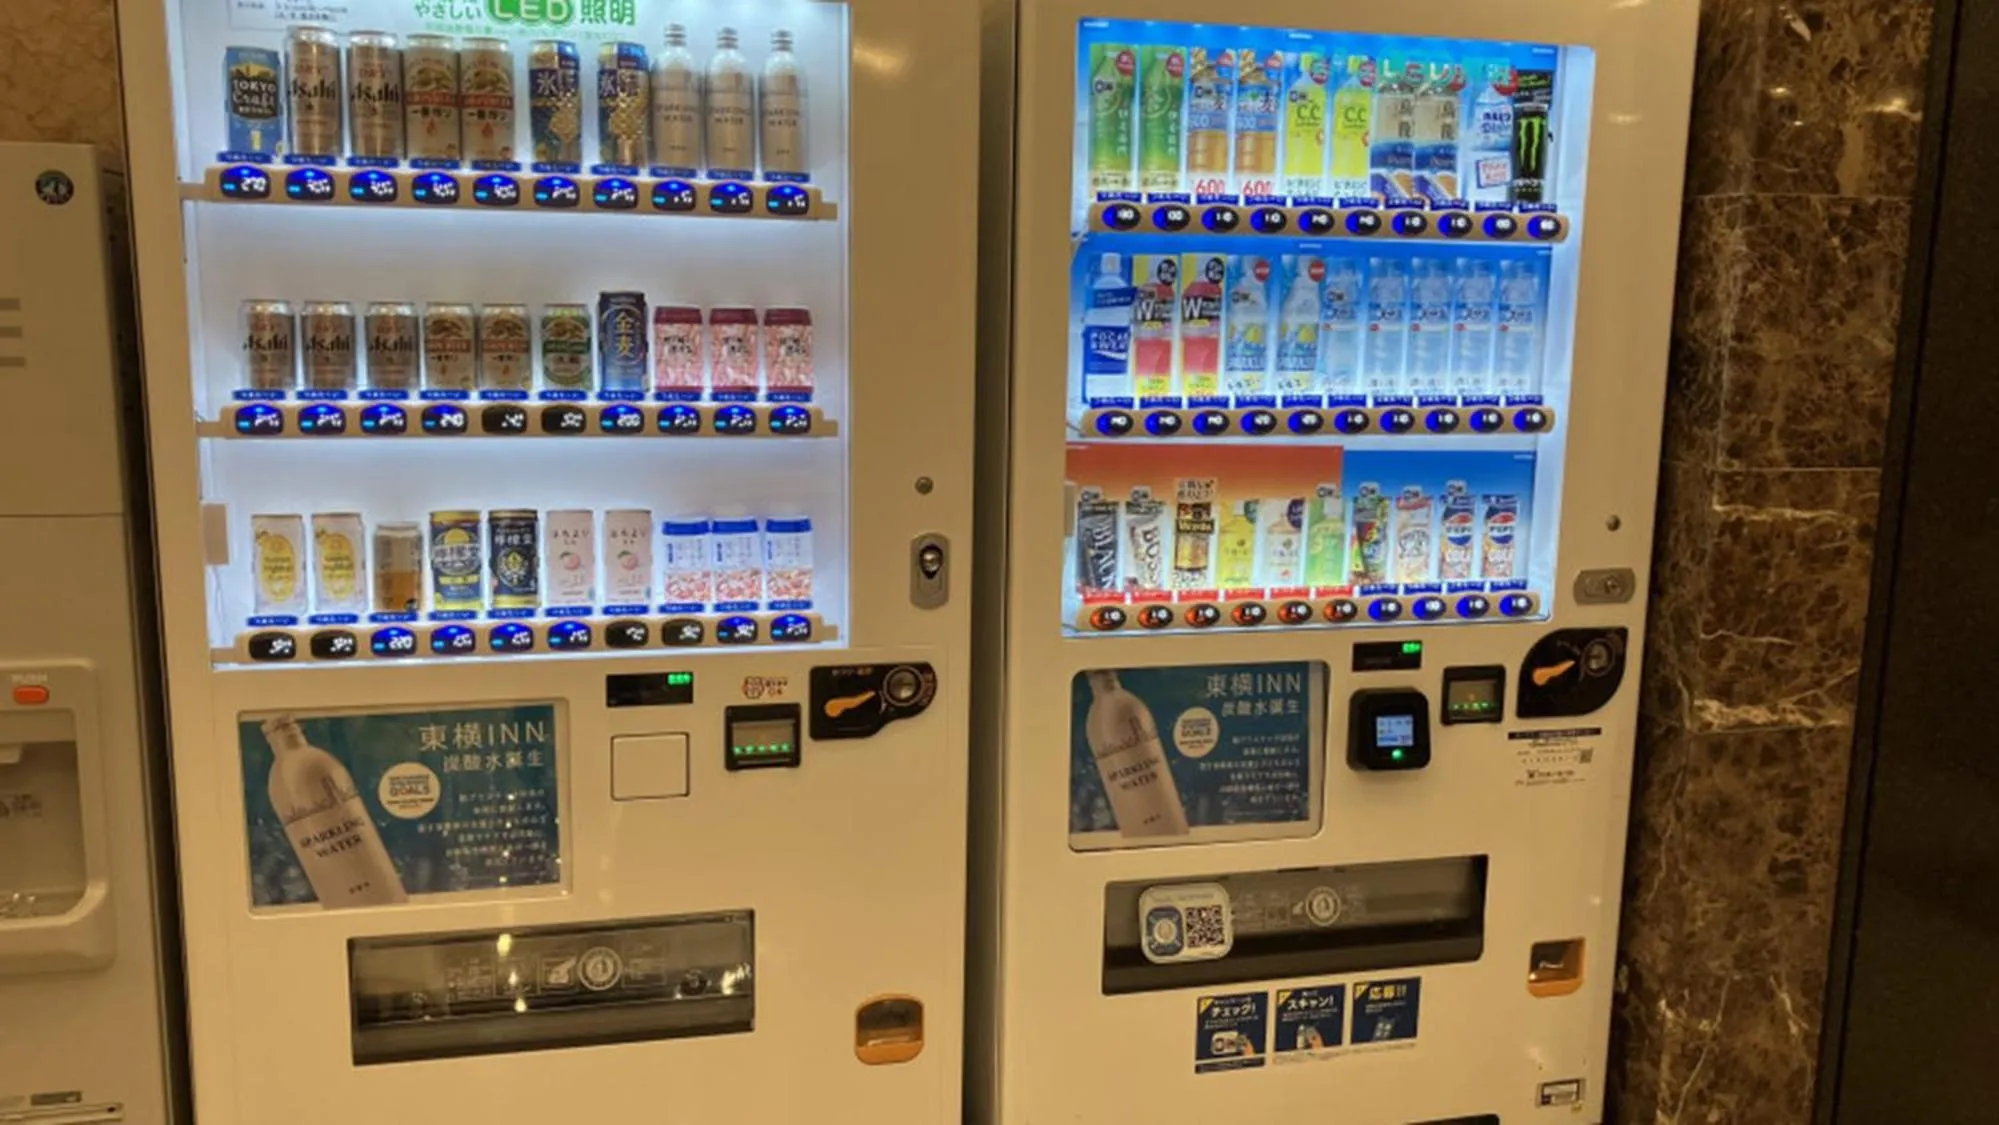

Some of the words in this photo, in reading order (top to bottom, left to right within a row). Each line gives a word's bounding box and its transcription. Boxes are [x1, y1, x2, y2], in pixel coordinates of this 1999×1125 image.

[415, 3, 481, 19] やさしい
[494, 0, 568, 21] LED
[580, 0, 636, 26] 照明
[615, 311, 635, 357] 金麦
[1205, 671, 1301, 698] 東横INN
[419, 720, 548, 752] 東横INN
[442, 750, 544, 773] 炭酸水誕生
[1211, 1003, 1256, 1018] チェック!
